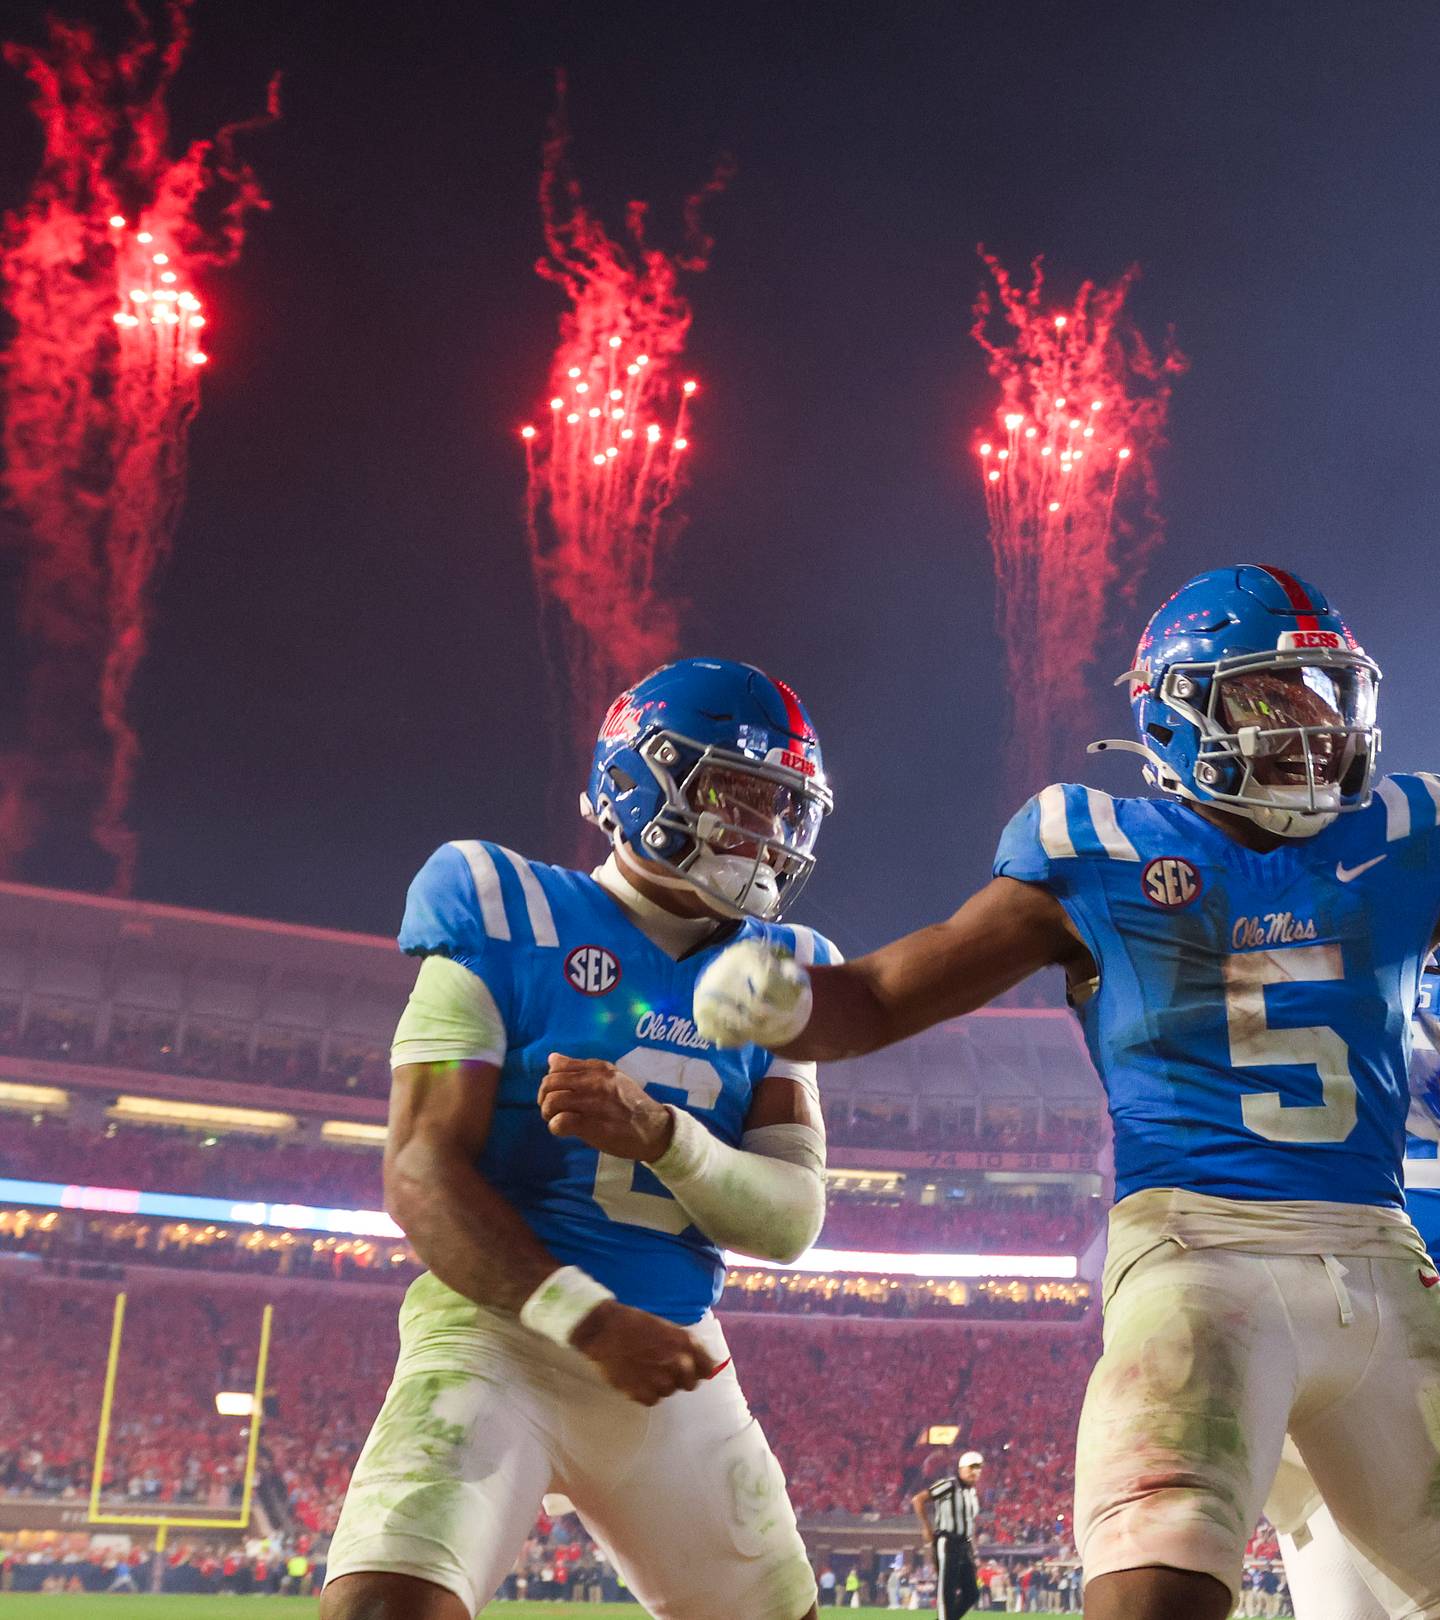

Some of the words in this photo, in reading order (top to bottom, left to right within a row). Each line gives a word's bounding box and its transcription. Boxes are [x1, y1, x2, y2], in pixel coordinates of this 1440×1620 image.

[1145, 859, 1197, 905] SEC
[1232, 916, 1265, 949] Ole
[1264, 911, 1318, 944] Miss
[569, 948, 617, 993] SEC
[635, 1010, 667, 1041] Ole
[1222, 943, 1359, 1144] 5
